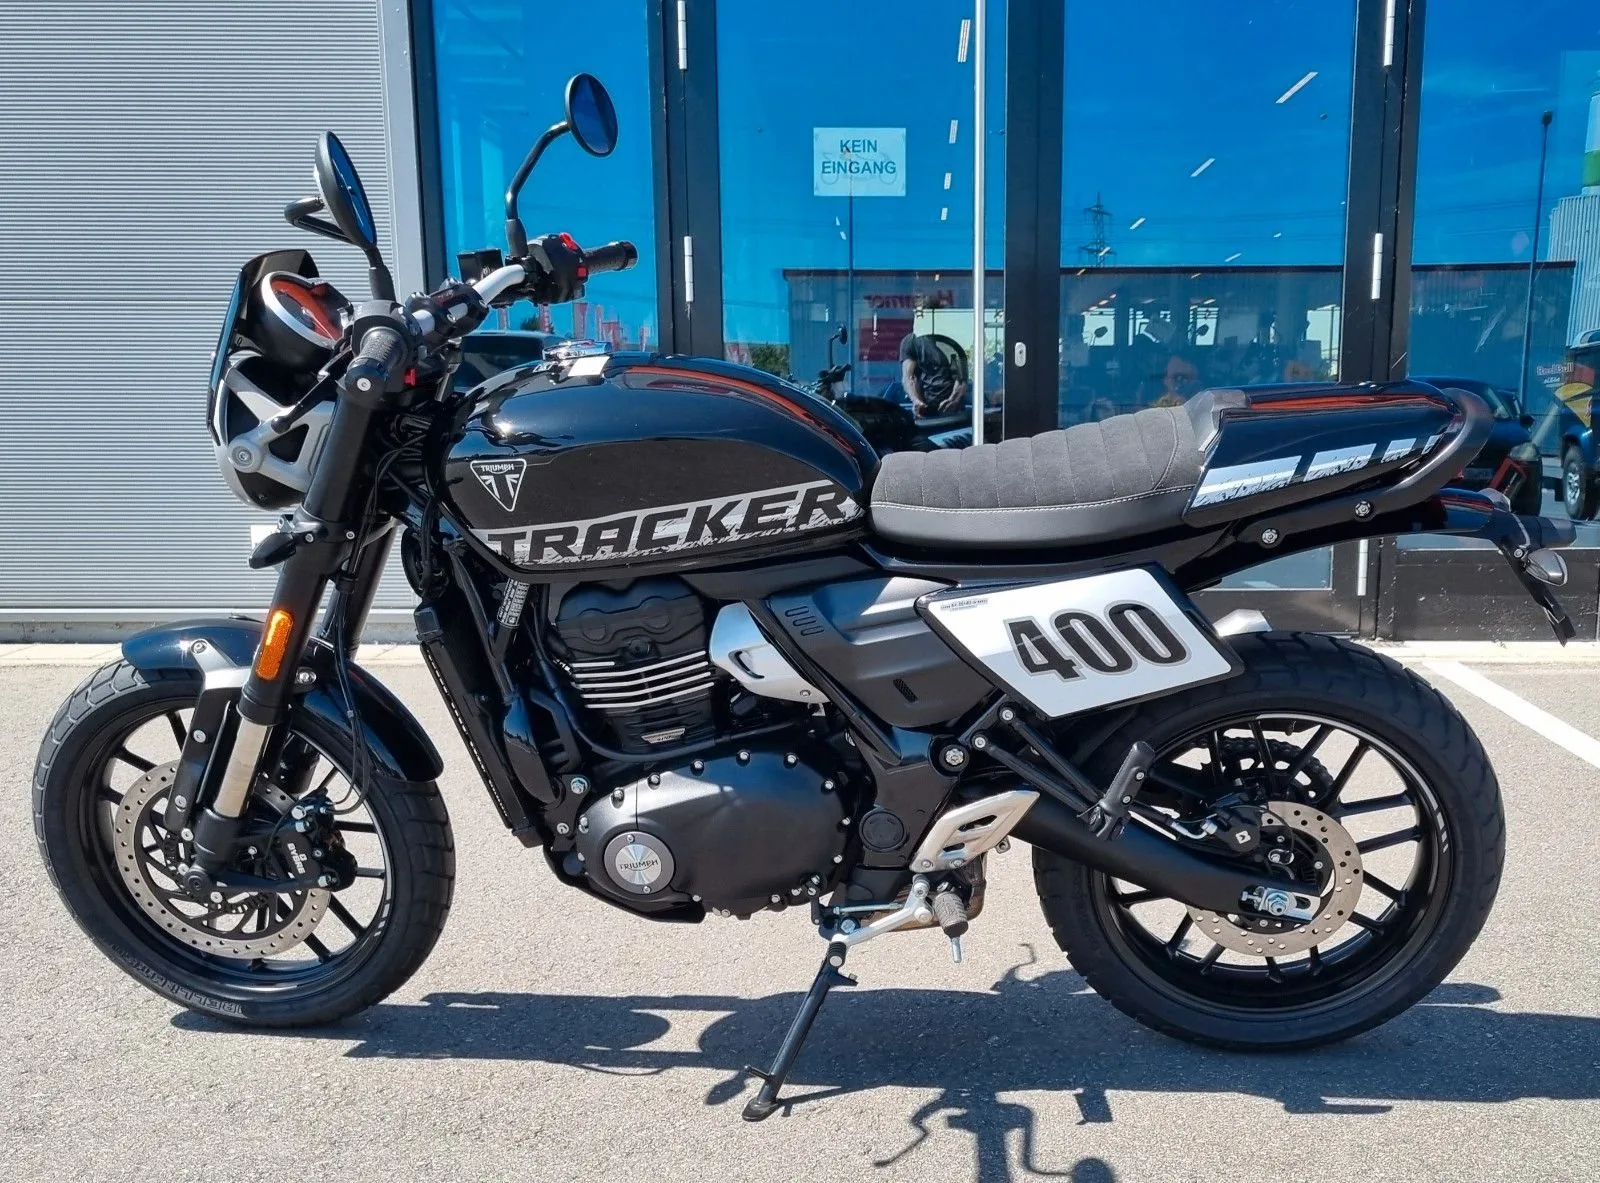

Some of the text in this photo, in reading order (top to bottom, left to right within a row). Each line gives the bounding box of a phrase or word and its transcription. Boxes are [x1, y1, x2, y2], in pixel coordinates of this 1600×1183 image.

[839, 139, 878, 153] KEIN
[821, 160, 897, 175] EINGANG
[480, 463, 515, 473] TRIUMPH
[487, 483, 851, 563] TRACKER
[1003, 600, 1192, 683] 400
[619, 859, 659, 871] TRIUMPH
